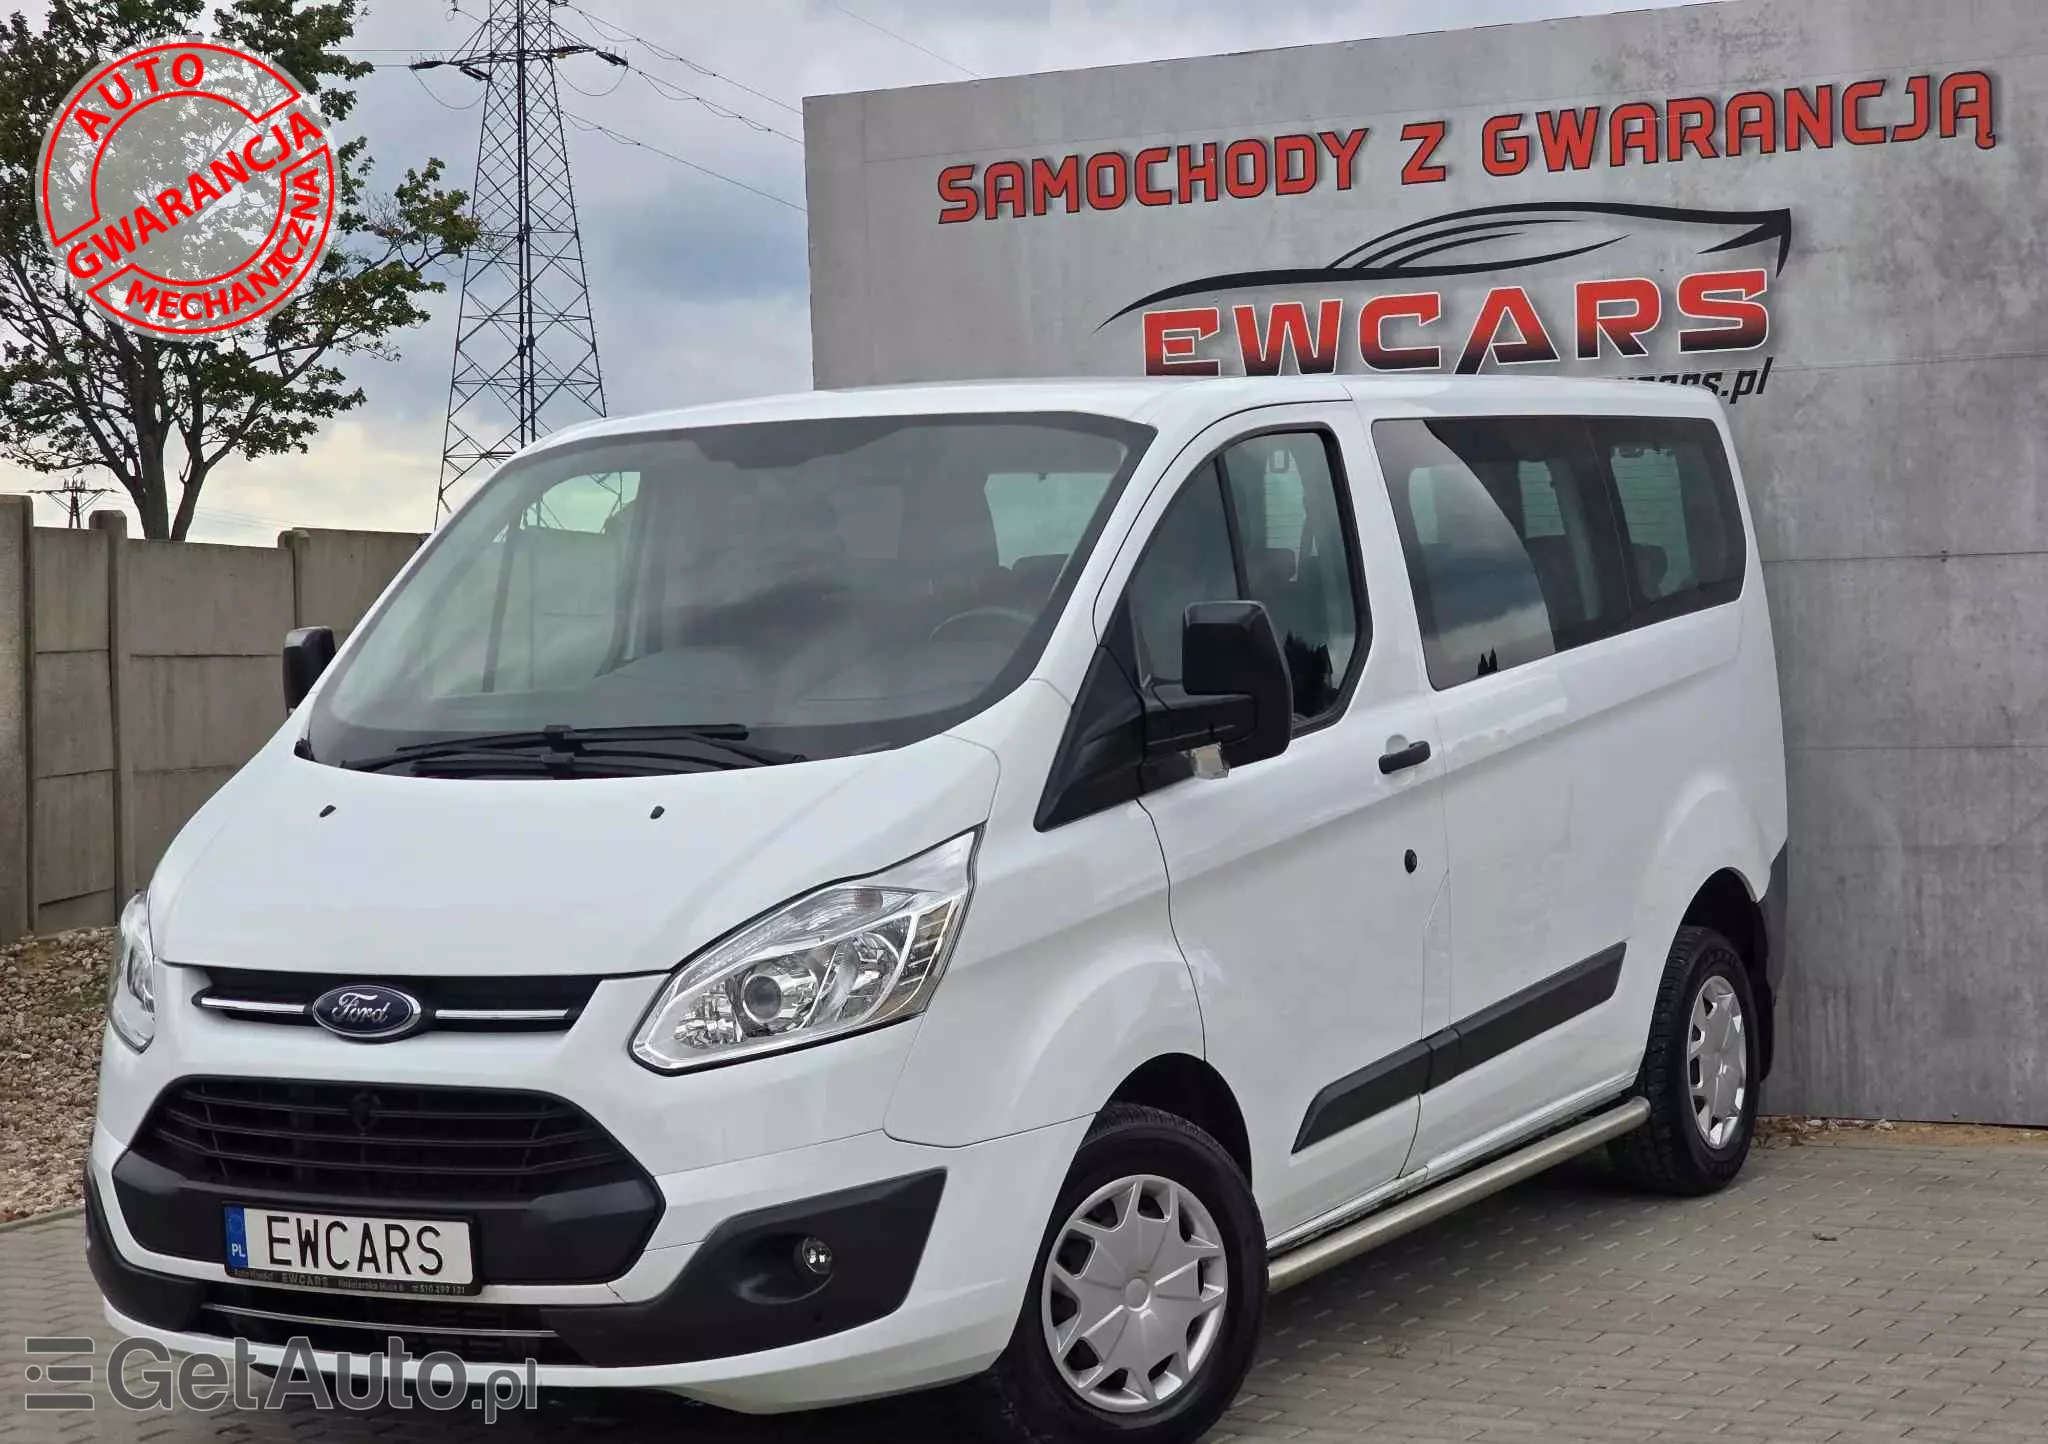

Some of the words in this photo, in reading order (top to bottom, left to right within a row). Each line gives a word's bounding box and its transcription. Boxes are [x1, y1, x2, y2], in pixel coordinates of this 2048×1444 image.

[938, 128, 1369, 224] SAMOCHODY
[1401, 121, 1447, 185] Z
[1482, 71, 1996, 177] GWARANCJĄ
[1143, 268, 1769, 376] EWCARS
[332, 992, 390, 1024] Ford
[232, 1243, 246, 1258] PL
[266, 1215, 444, 1276] EWCARS
